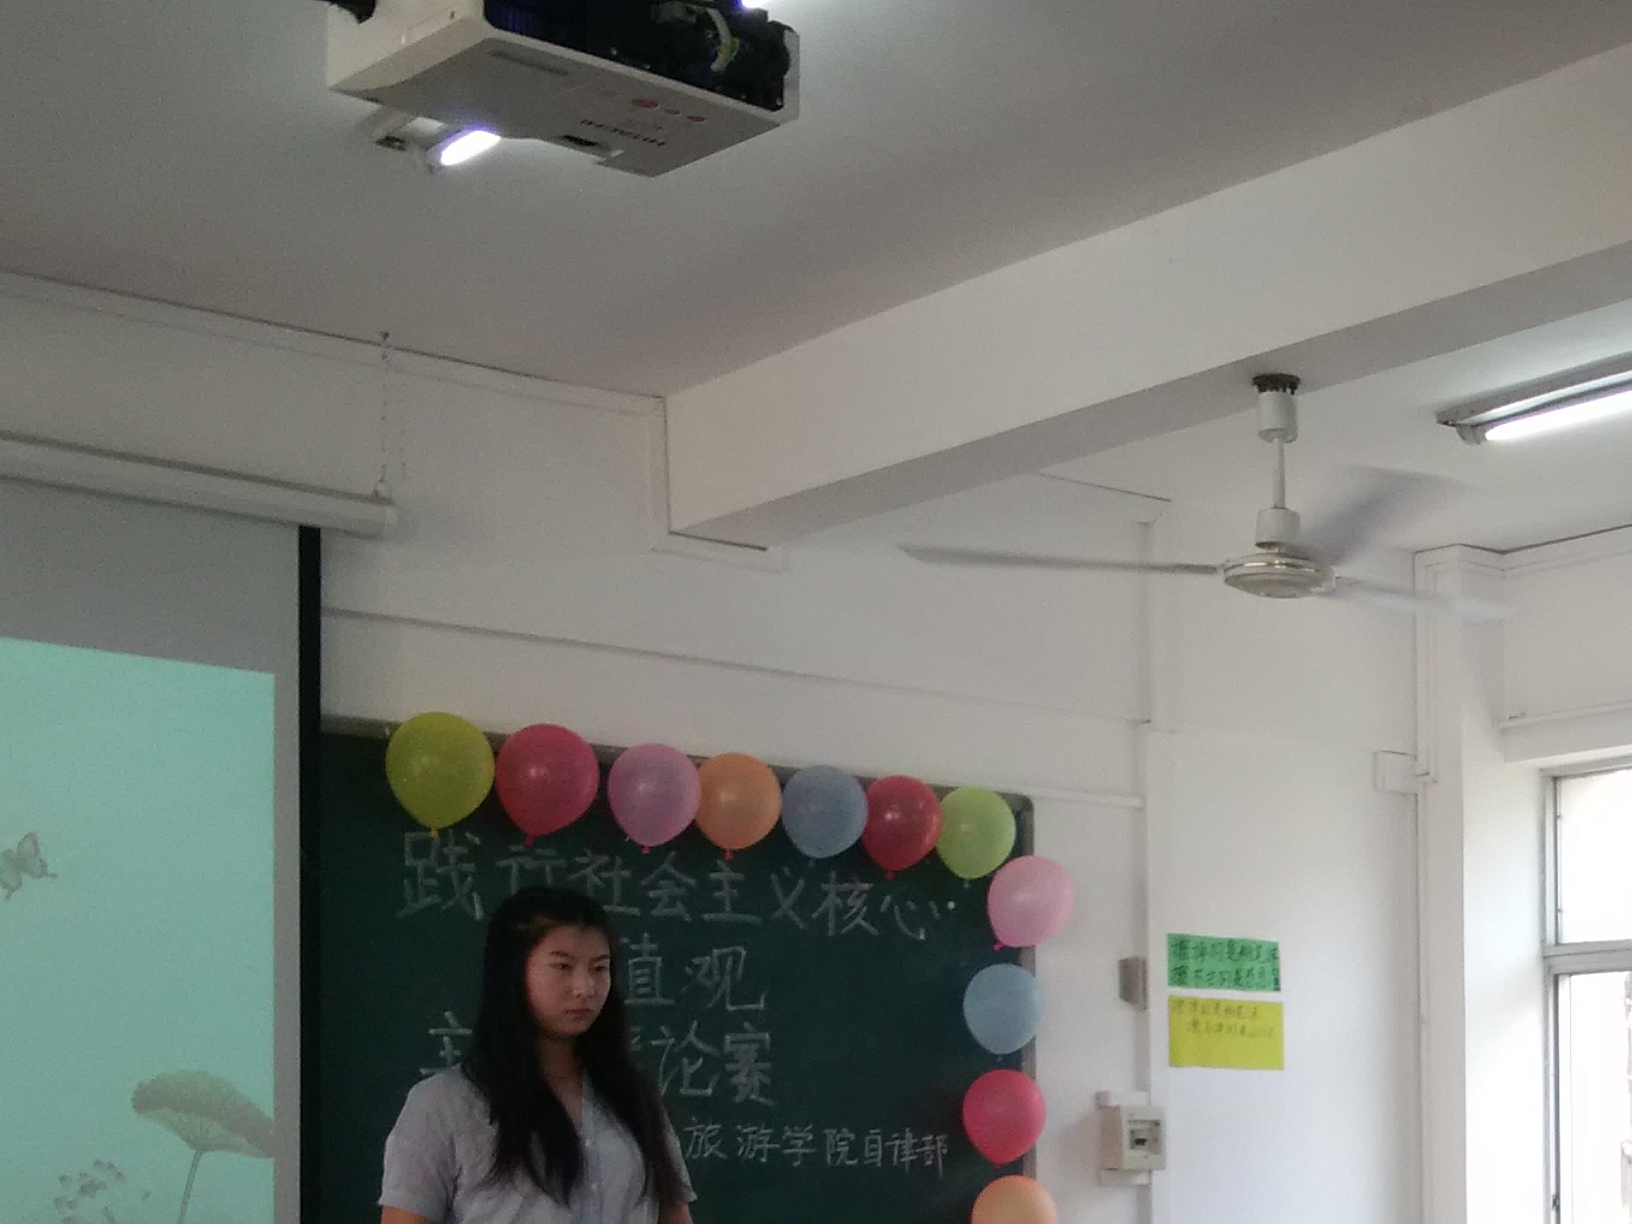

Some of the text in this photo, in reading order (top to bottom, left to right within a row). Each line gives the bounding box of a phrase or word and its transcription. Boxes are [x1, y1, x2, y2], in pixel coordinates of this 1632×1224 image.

[683, 1116, 949, 1179] 旅游学院自律部
